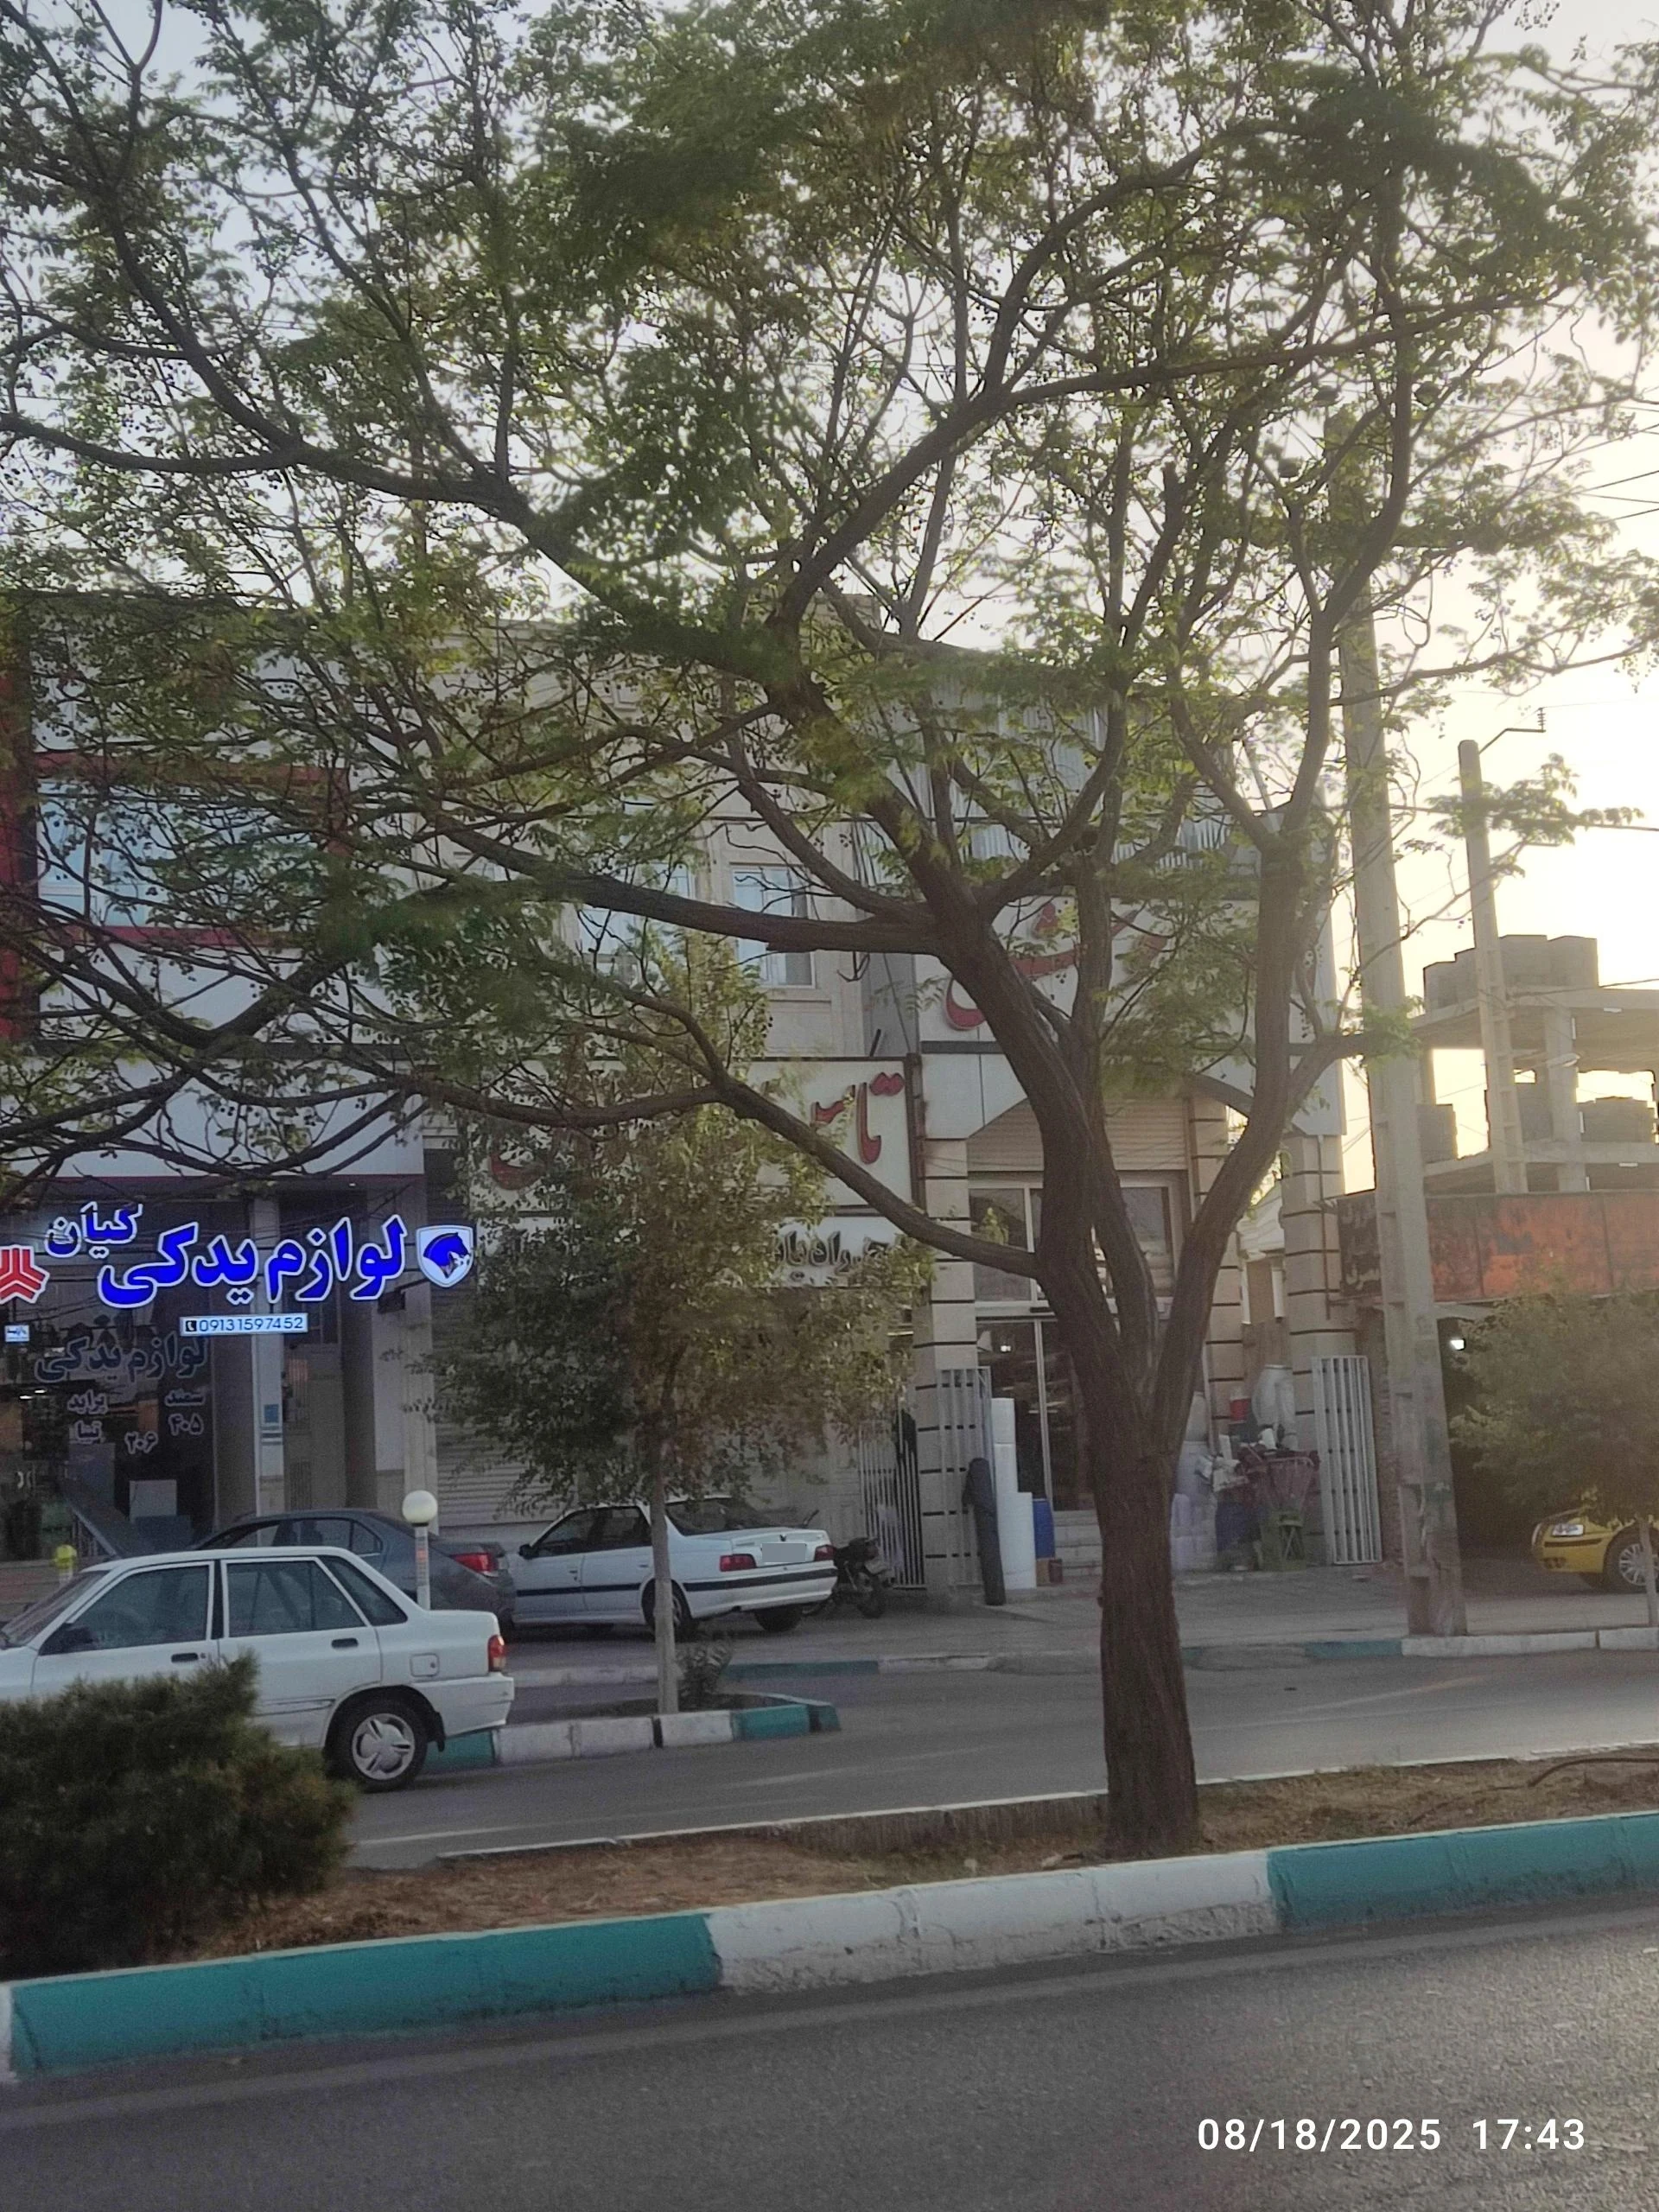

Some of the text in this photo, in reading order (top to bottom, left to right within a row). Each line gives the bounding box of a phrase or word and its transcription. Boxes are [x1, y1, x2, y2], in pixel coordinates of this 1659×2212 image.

[44, 1201, 143, 1258] کیان
[98, 1214, 408, 1308] لوازم یدکی
[199, 1317, 303, 1332] 09131597452
[35, 1332, 209, 1382] لوازم یدکی
